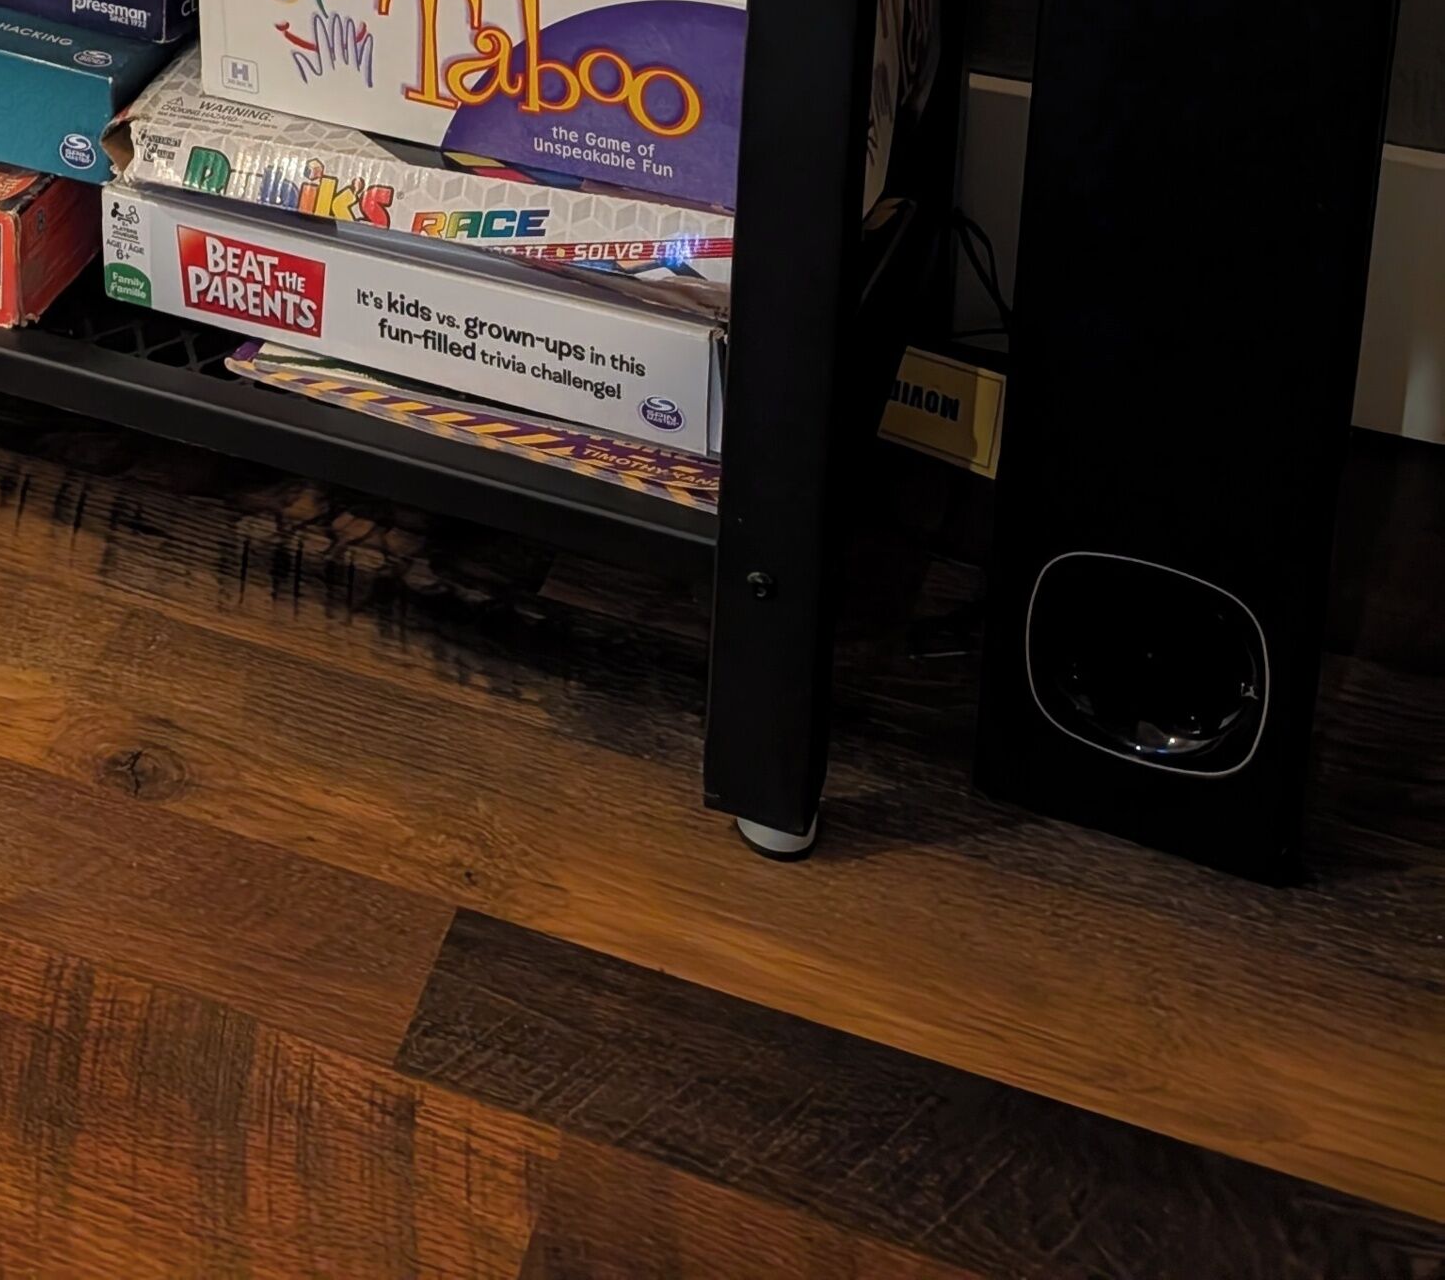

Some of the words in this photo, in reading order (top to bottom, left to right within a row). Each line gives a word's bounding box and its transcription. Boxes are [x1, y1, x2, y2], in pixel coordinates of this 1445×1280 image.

[109, 13, 130, 25] SINCE
[160, 104, 202, 119] CHOKING
[198, 100, 275, 123] WARNING:
[551, 125, 580, 145] the
[584, 130, 632, 154] Game
[637, 141, 656, 159] of
[533, 136, 637, 172] Unspeakable
[641, 159, 674, 179] Fun
[182, 144, 396, 231] Rbik's
[111, 224, 138, 236] PLAYERS
[410, 208, 551, 239] RACE
[106, 237, 122, 250] AGE
[115, 248, 131, 261] 6+
[204, 235, 280, 287] BEAT
[273, 271, 307, 294] THE
[109, 282, 147, 301] Famille
[111, 271, 146, 290] Family
[187, 265, 318, 330] PARENTS
[355, 286, 384, 313] It's
[386, 290, 433, 325] kids
[434, 311, 462, 331] vs.
[463, 315, 586, 363] grown-ups
[589, 345, 606, 367] in
[609, 353, 648, 378] this
[376, 317, 478, 363] fun-filled
[480, 348, 527, 376] trivia
[529, 362, 623, 401] challenge!
[645, 408, 678, 423] SPIN
[581, 446, 670, 477] TIMOTHY
